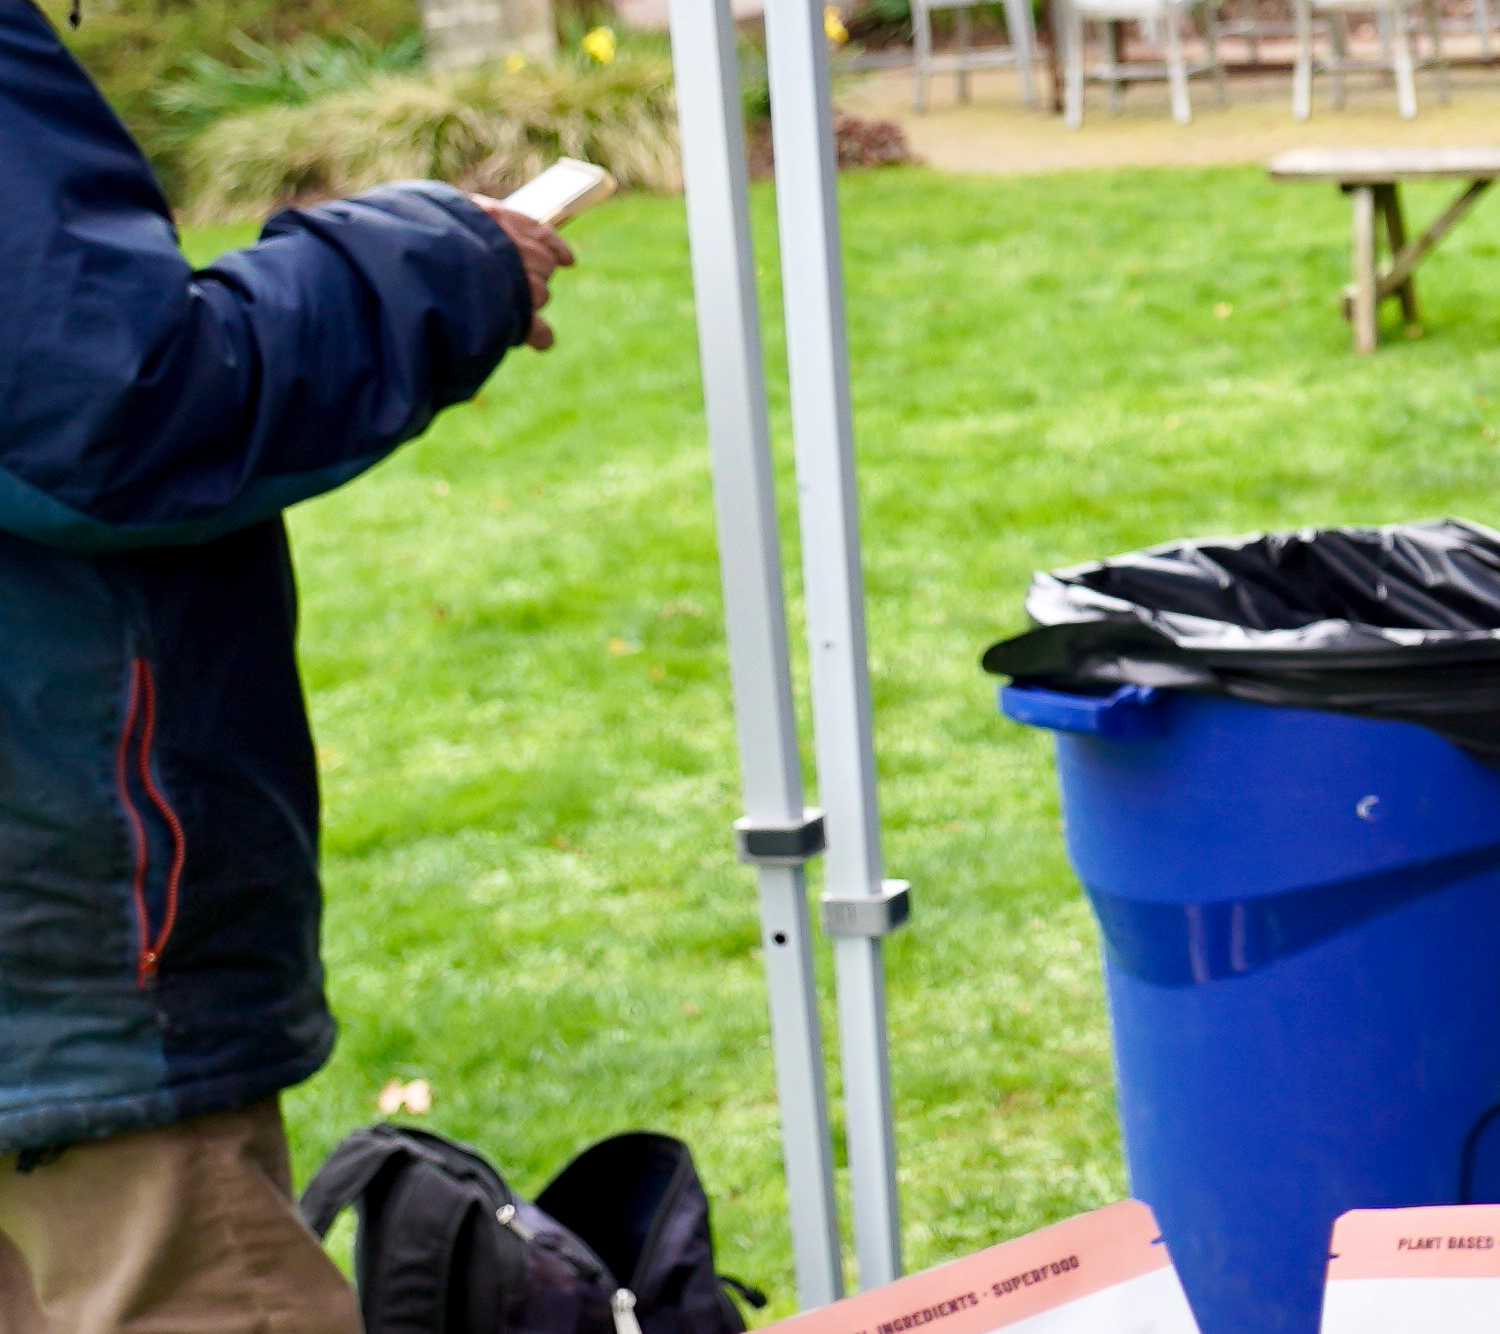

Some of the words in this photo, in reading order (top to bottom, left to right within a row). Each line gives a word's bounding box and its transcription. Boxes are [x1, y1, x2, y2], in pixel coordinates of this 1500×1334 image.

[1397, 1236, 1443, 1251] PLANT
[1447, 1235, 1495, 1250] BASED
[991, 1254, 1081, 1298] SUPERFOOD
